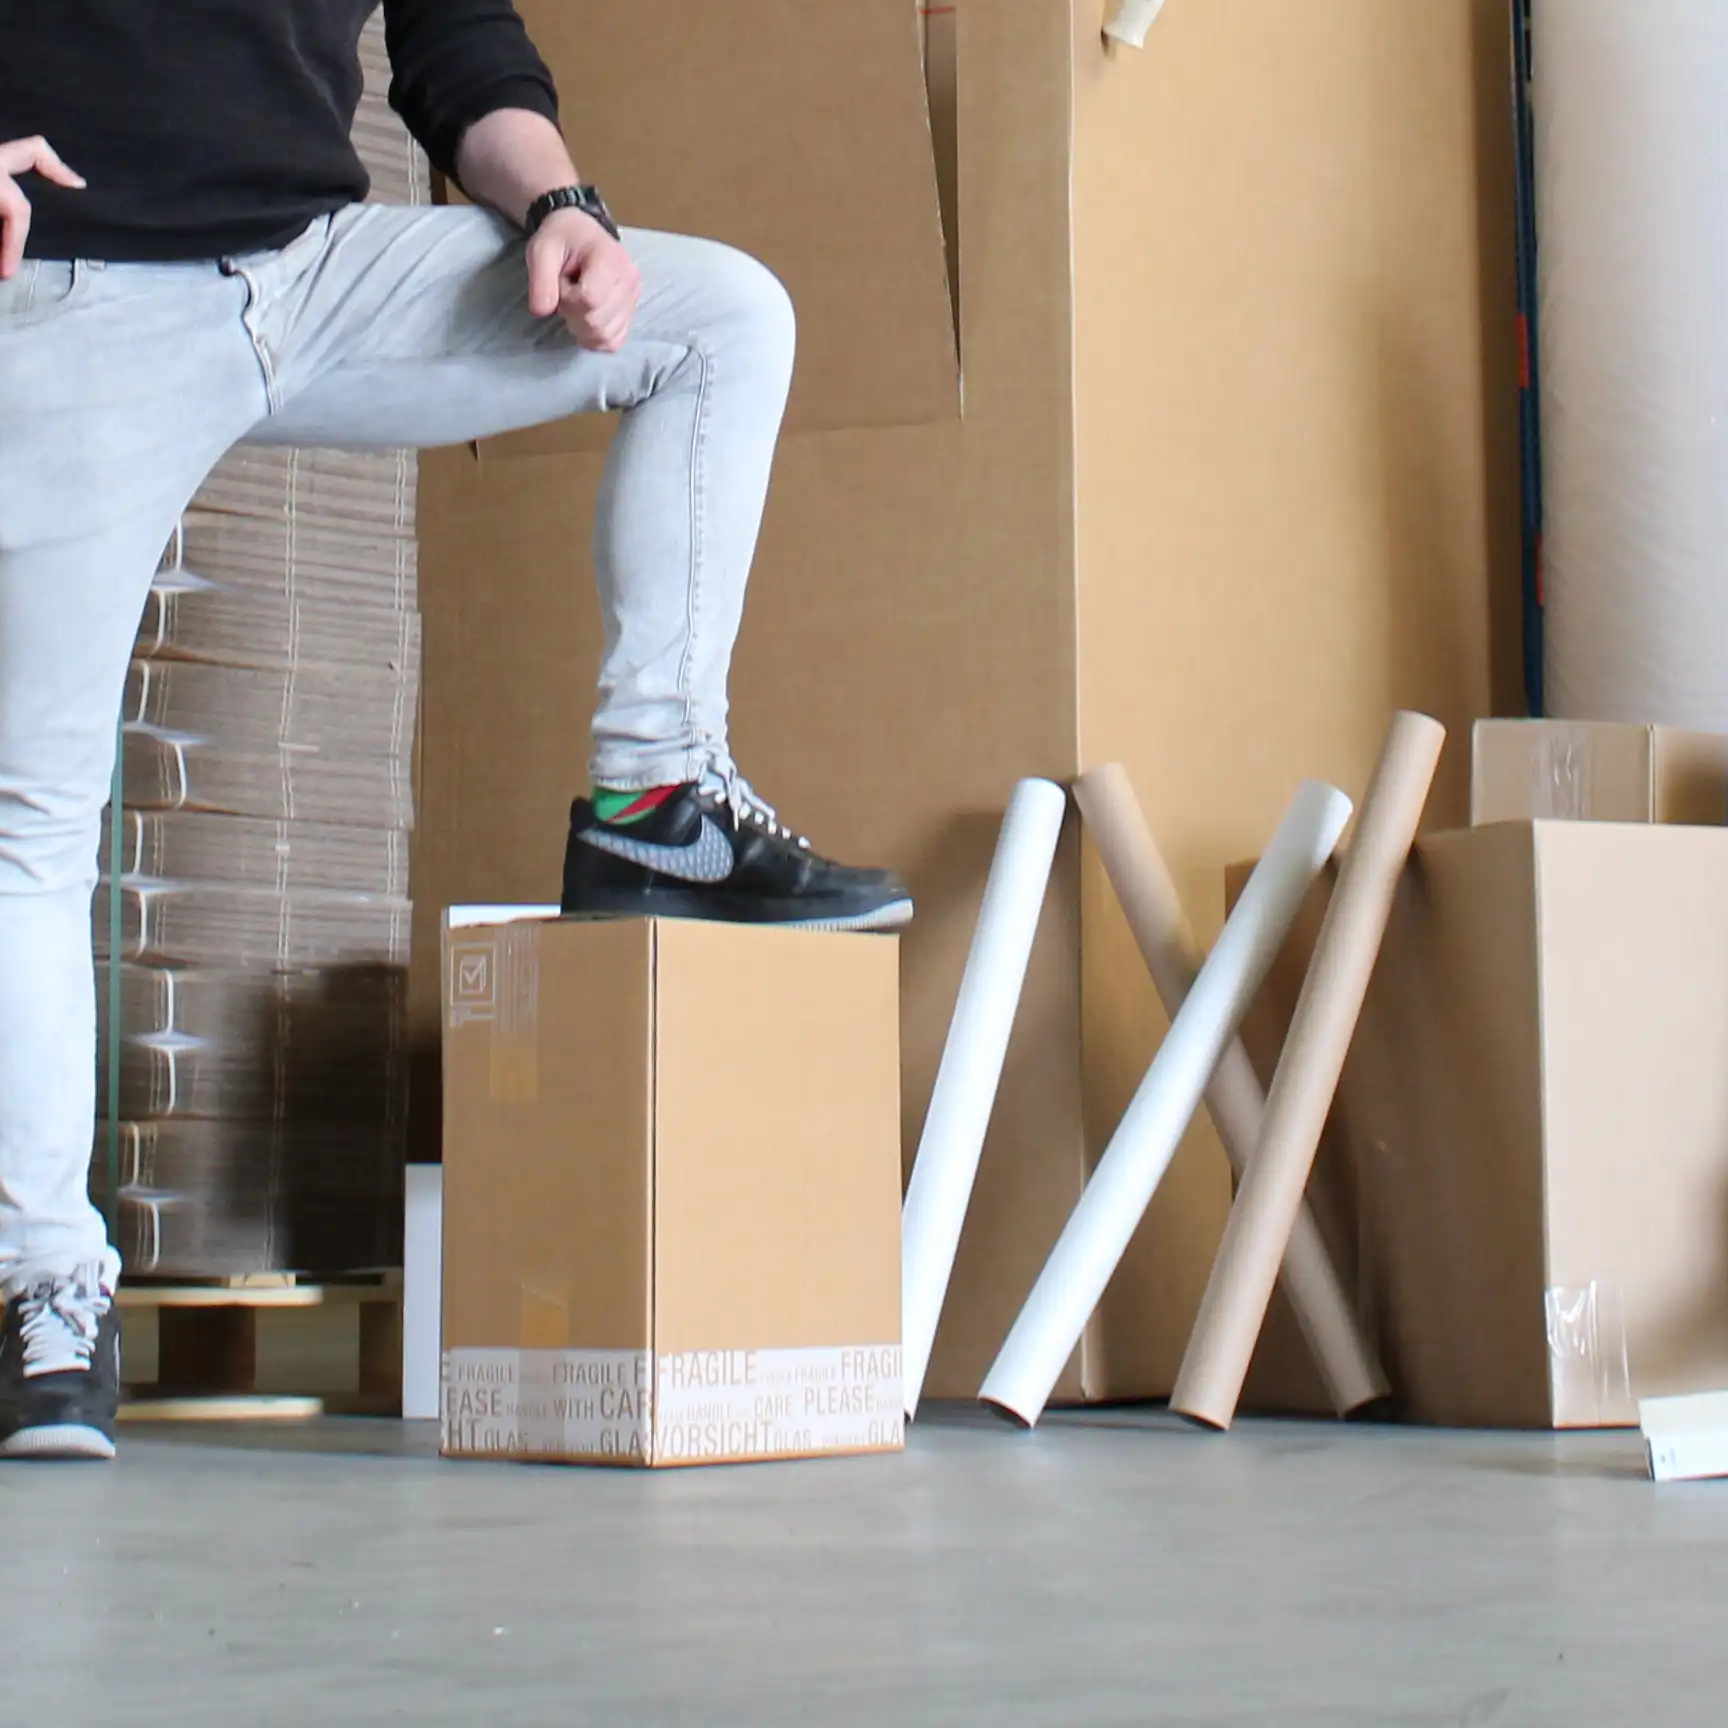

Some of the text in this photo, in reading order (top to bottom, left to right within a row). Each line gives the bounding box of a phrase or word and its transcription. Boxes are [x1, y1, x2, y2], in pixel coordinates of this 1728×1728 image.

[458, 1361, 514, 1384] FRAGILE
[552, 1359, 623, 1385] FRAGILE
[657, 1349, 758, 1389] FRAGILE
[446, 1387, 503, 1418] EASE
[553, 1397, 595, 1419] WITH
[754, 1394, 793, 1419] CARE
[804, 1384, 875, 1416] PLEASE
[656, 1419, 772, 1459] VORSICHT
